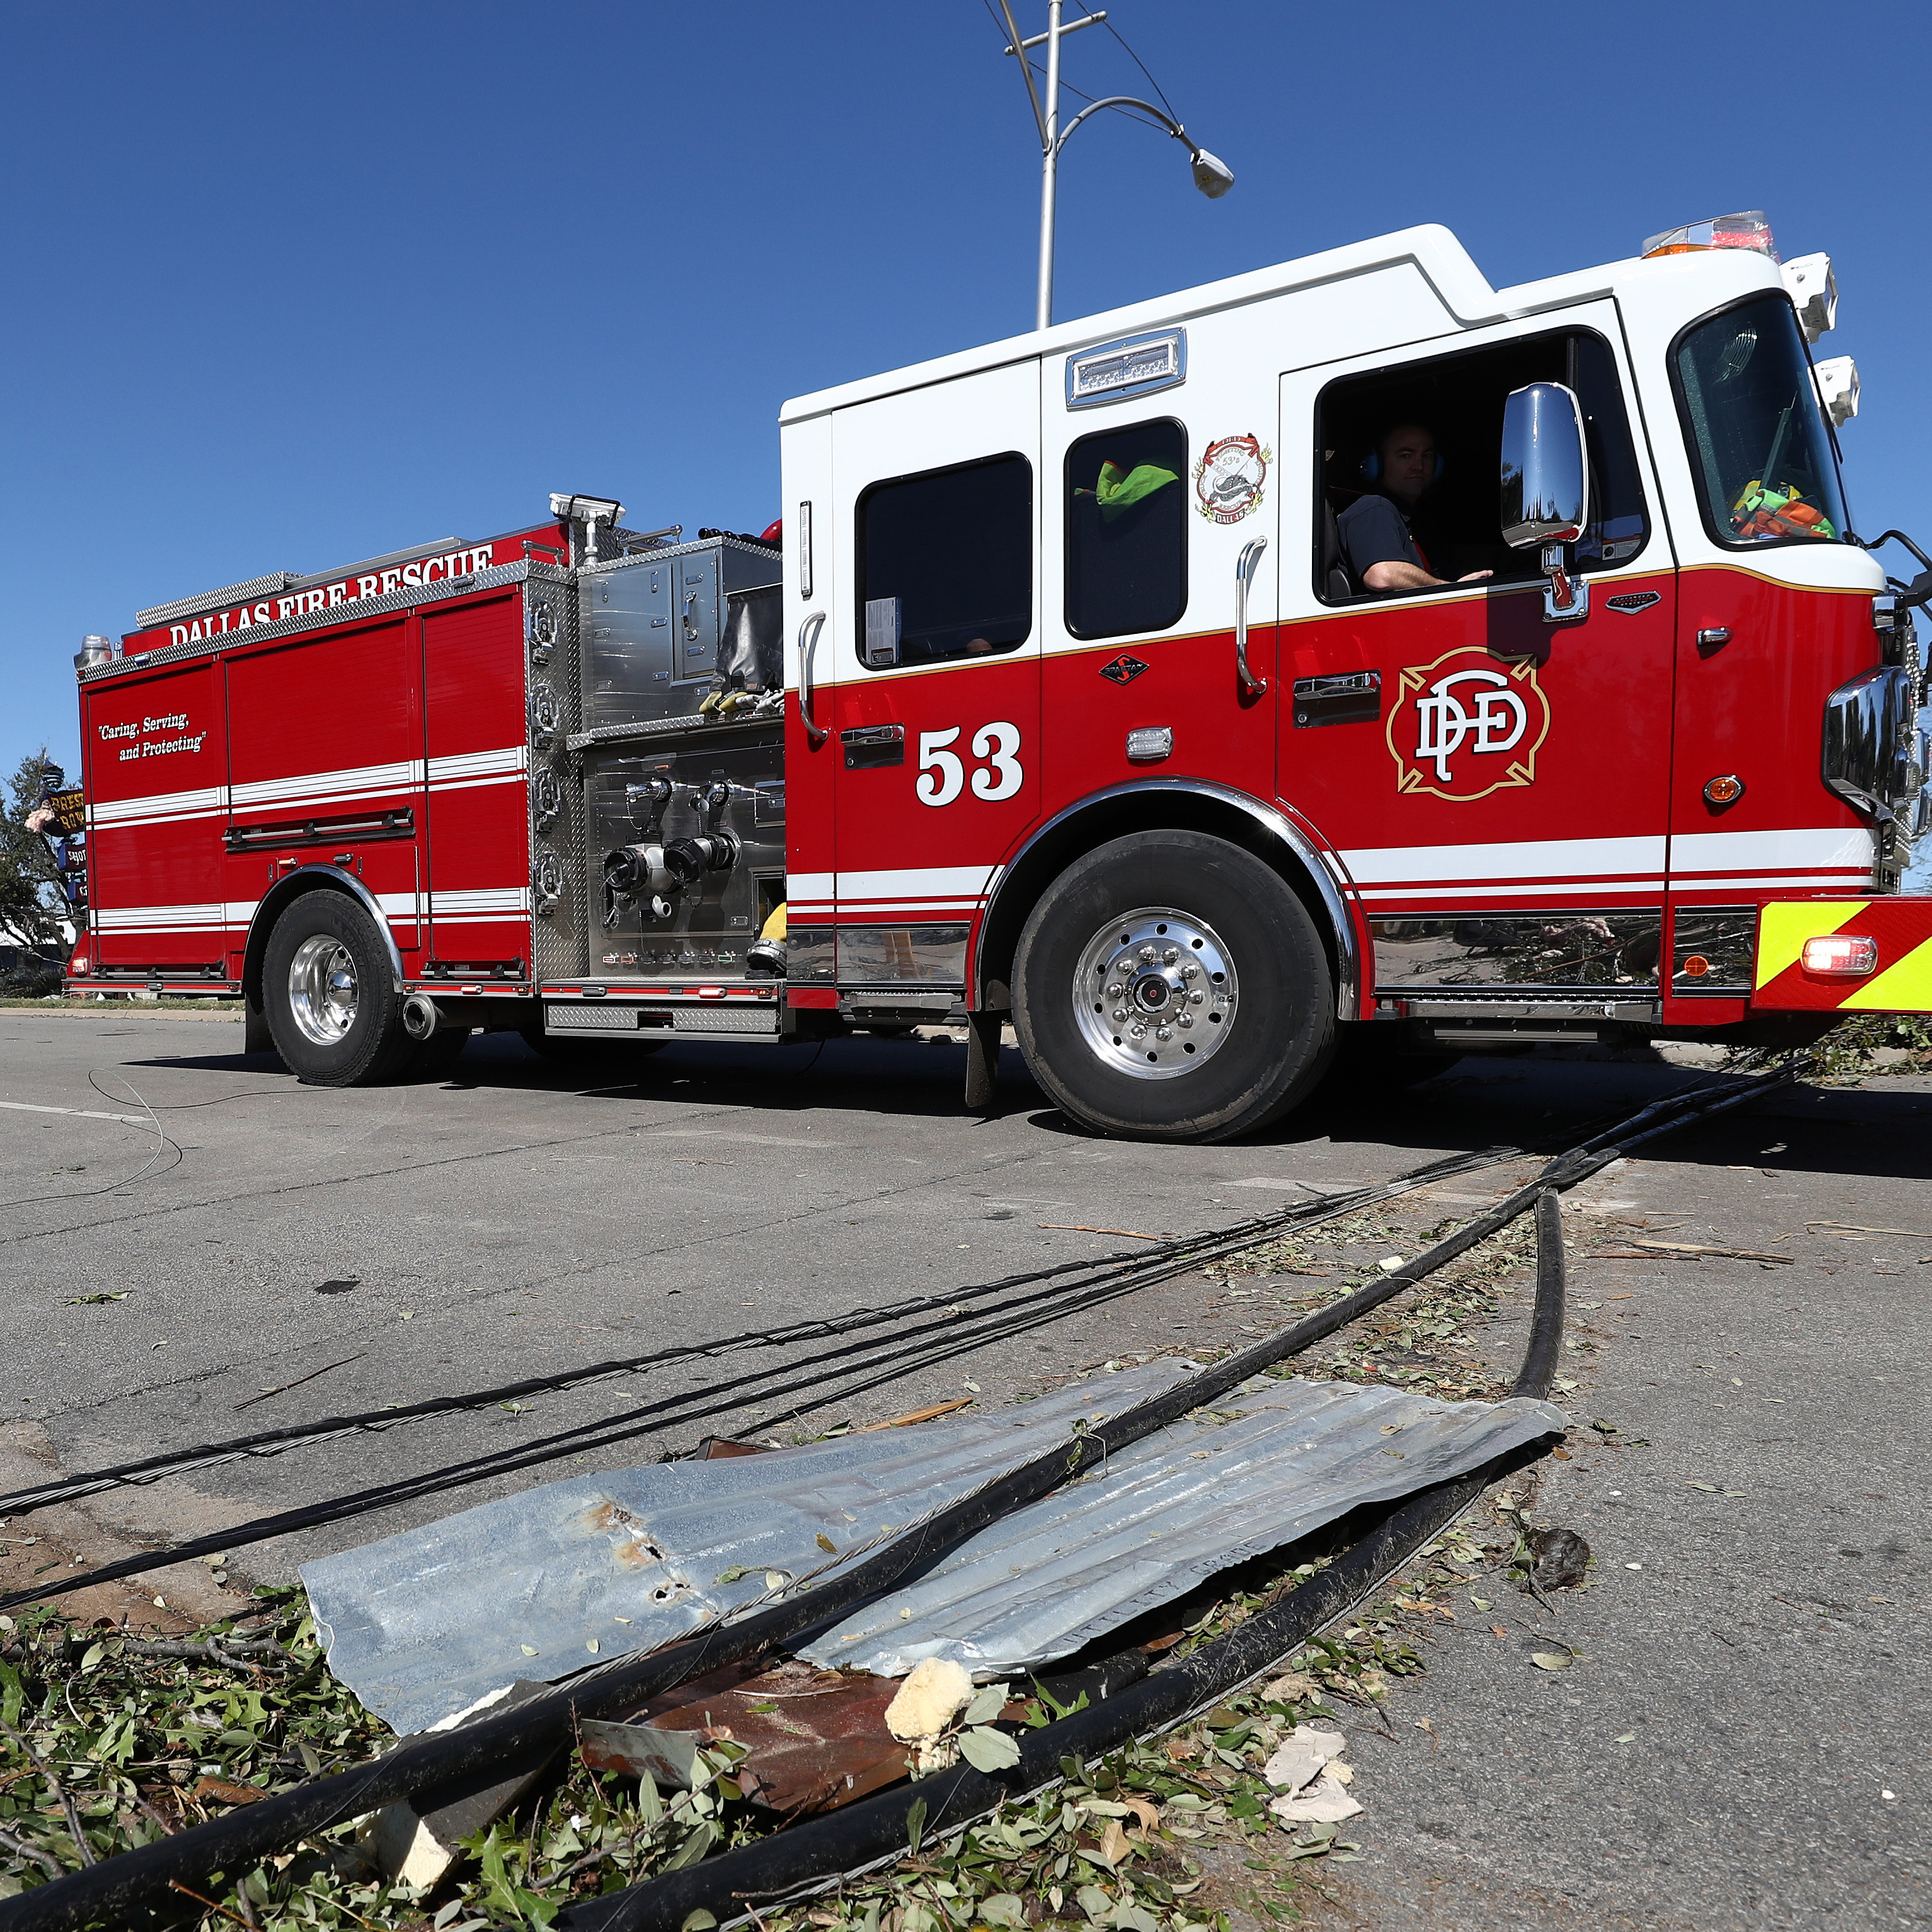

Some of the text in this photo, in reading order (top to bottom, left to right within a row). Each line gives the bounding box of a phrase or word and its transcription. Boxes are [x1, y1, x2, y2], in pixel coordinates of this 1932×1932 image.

[1217, 511, 1245, 524] DALLAS
[170, 602, 272, 646] DALLAS
[142, 713, 190, 730] Serving,
[119, 744, 140, 762] and
[916, 721, 1025, 808] 53
